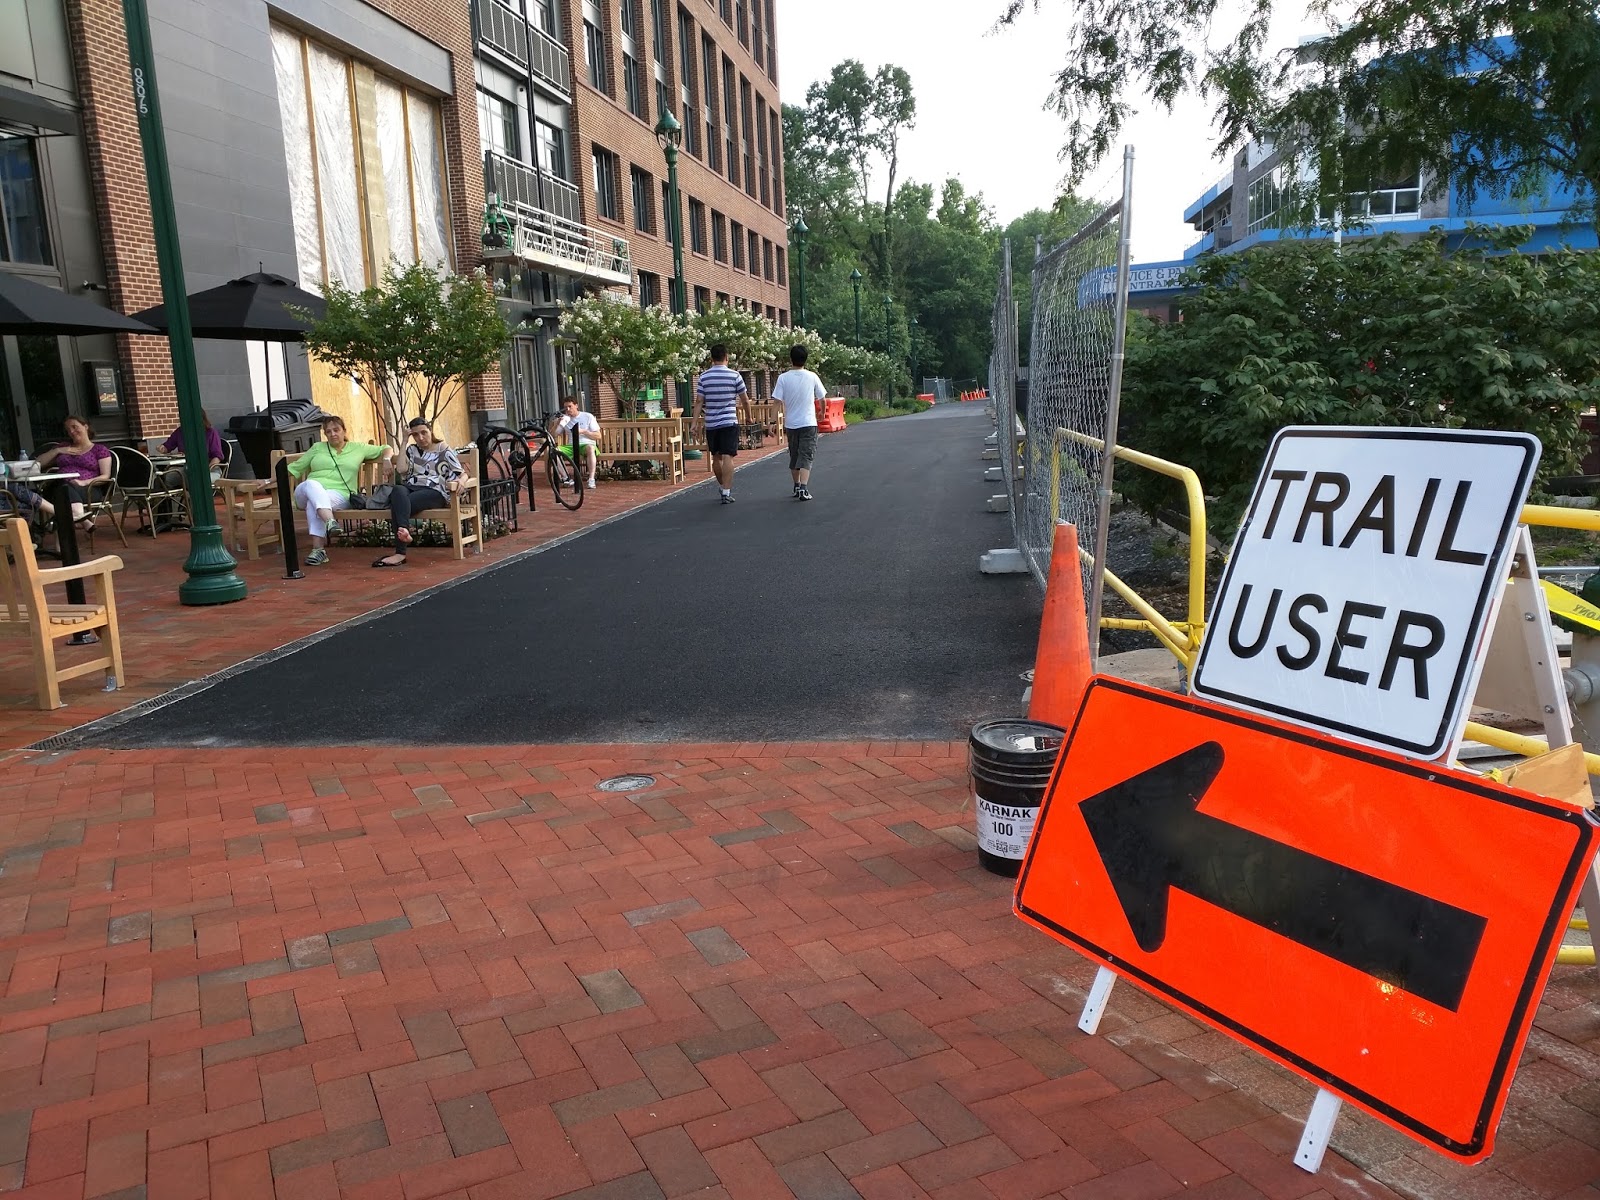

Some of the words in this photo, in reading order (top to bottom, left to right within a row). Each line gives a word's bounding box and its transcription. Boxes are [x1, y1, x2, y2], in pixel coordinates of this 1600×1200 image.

[1103, 269, 1153, 284] SEVICE
[1156, 268, 1165, 279] &
[1261, 469, 1489, 567] TRAIL
[1227, 583, 1446, 701] USER
[979, 798, 1032, 819] KARNAK
[991, 820, 1013, 837] 100
